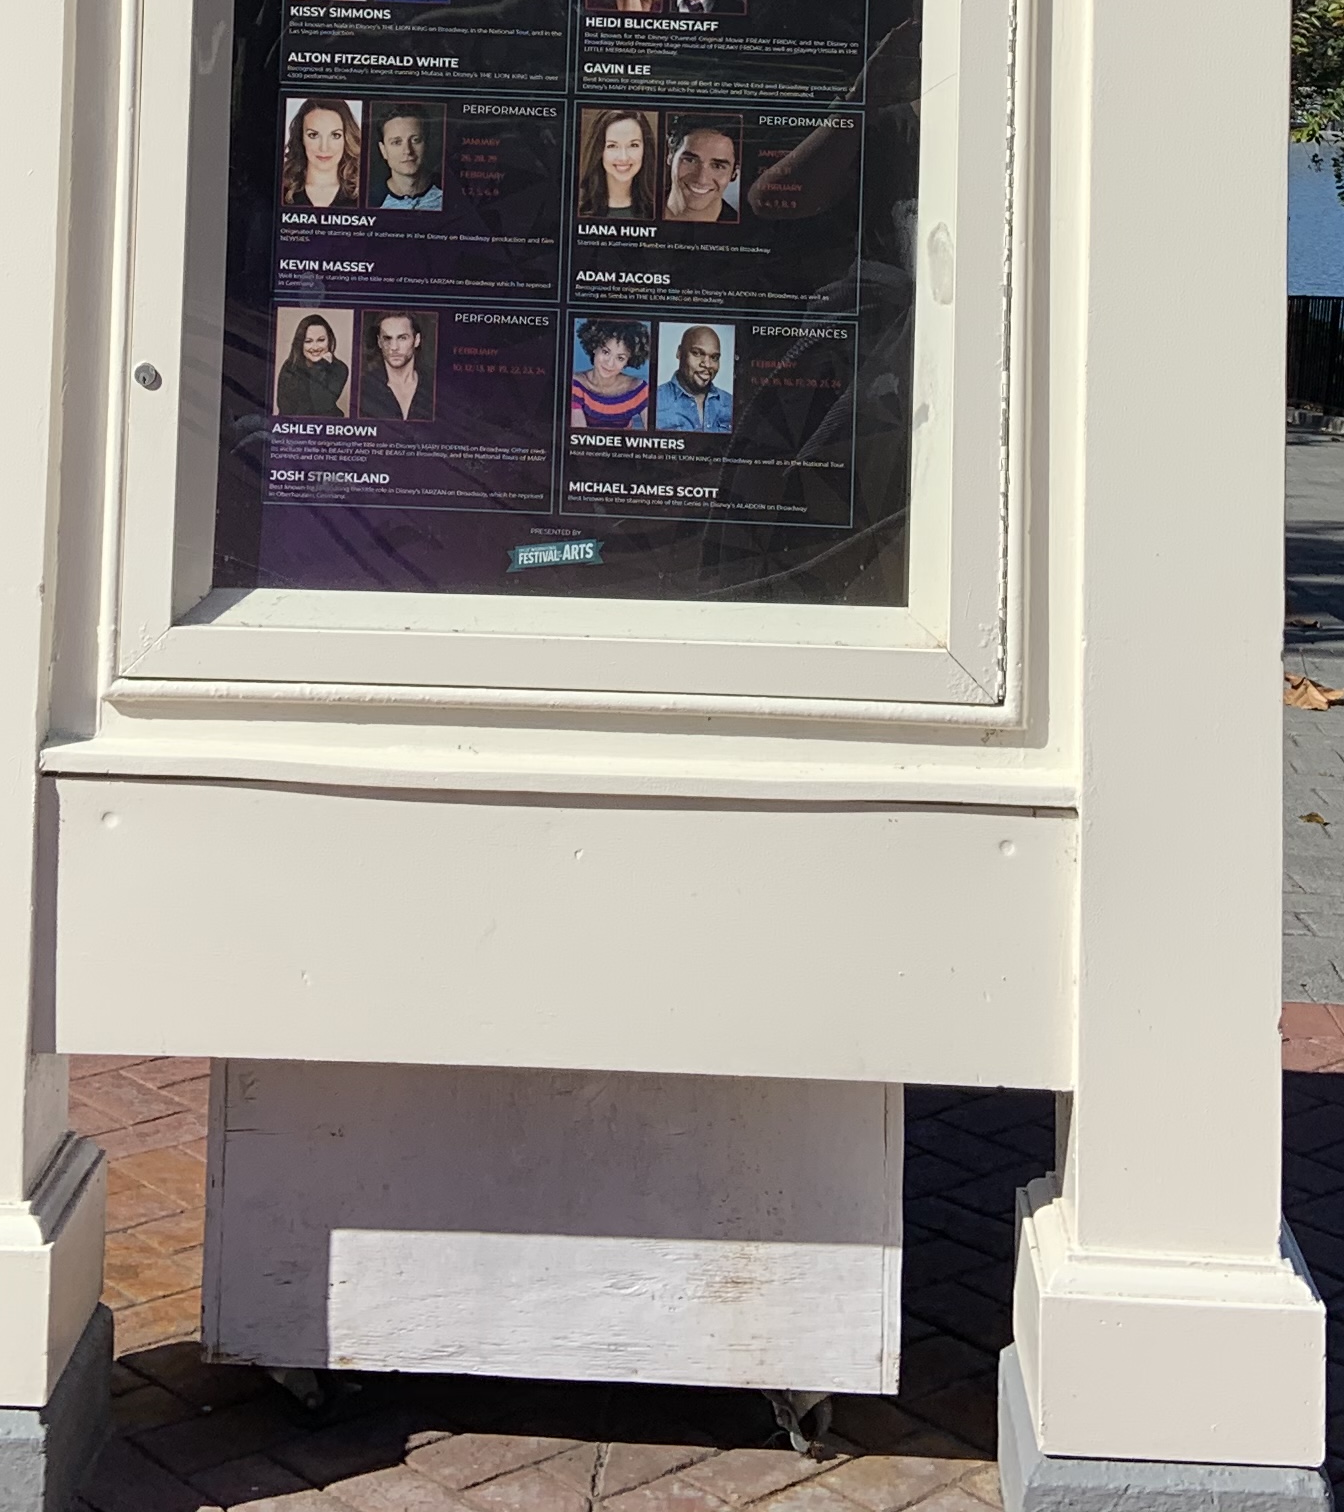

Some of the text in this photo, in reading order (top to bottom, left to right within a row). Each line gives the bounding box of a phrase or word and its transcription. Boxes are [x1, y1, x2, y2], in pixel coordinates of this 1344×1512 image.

[289, 6, 391, 19] KISSY SIMMONS
[585, 16, 719, 31] HEIDI BLICKENSTAFF
[287, 51, 459, 68] ALTON FITZGERALD WHITE
[583, 62, 651, 75] GAVIN LEE
[462, 103, 557, 117] PERFORMANCES
[758, 115, 854, 128] PERFORMANCES
[459, 170, 505, 179] FEBRUARY
[281, 212, 376, 226] KARA LINDSAY
[577, 224, 657, 237] LIANA HUNT
[279, 258, 375, 272] KEVIN MASSEY
[575, 270, 670, 284] ADAM JACOBS
[454, 312, 549, 326] PERFORMANCES
[752, 325, 848, 339] PERFORMANCES
[271, 422, 377, 437] ASHLEY BROWN
[570, 434, 685, 450] SYNDEE WINTERS
[269, 469, 390, 484] JOSH STRICKLAND
[568, 481, 719, 498] MICHAEL JAMES SCOTT
[530, 528, 571, 536] PRESENTED
[518, 549, 560, 565] FESTIVAL
[562, 542, 594, 561] ARTS
